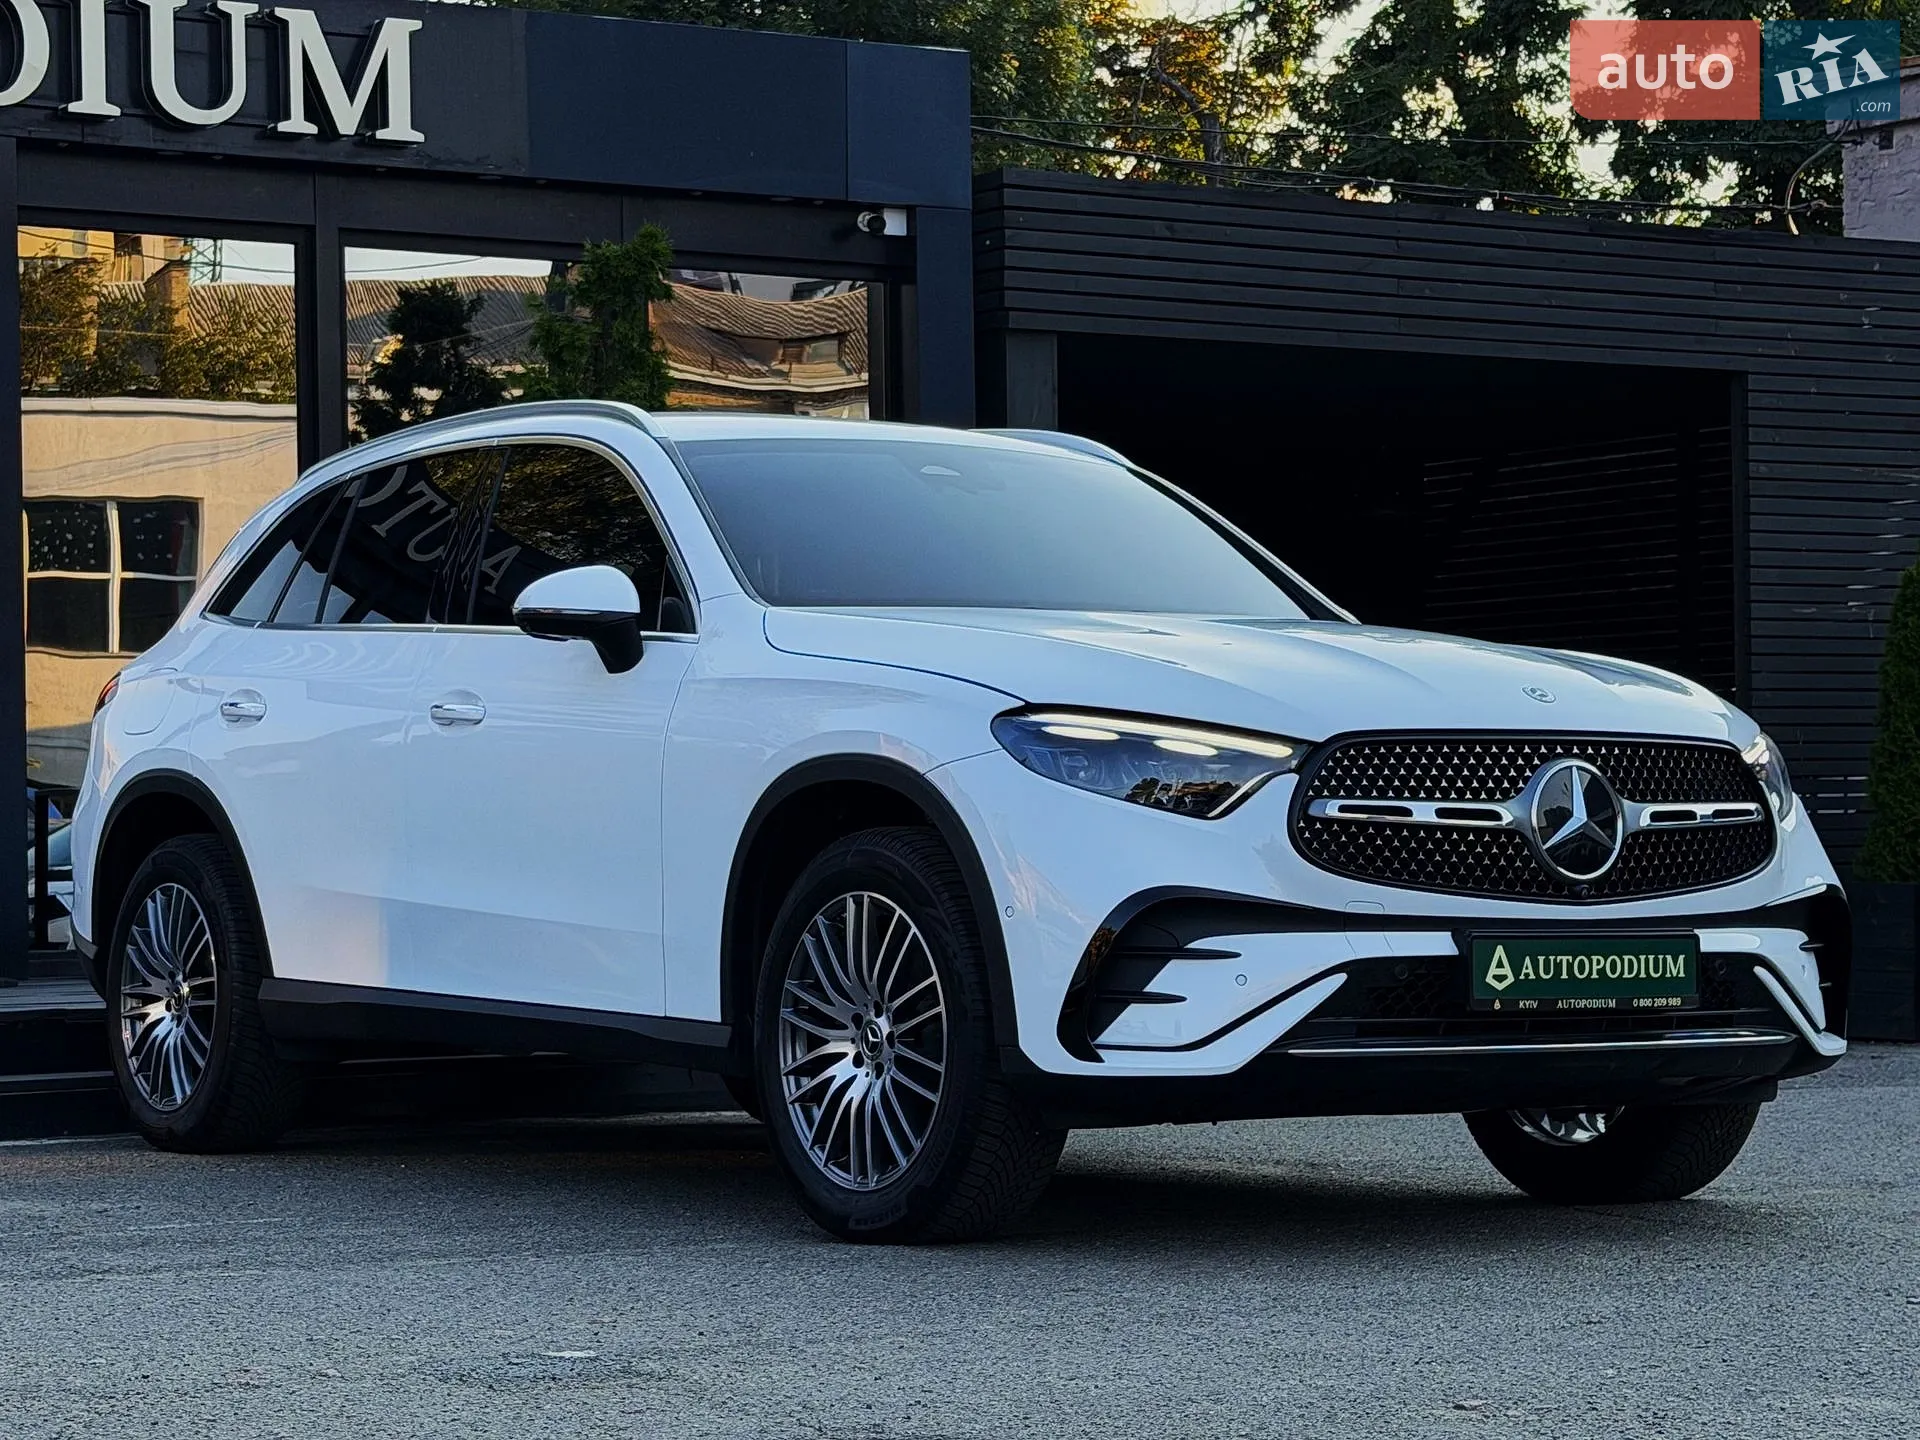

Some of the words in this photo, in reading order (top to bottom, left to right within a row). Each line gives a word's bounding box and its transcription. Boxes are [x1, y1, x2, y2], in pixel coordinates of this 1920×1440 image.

[1519, 954, 1686, 979] AUTOPODIUM
[1519, 1000, 1538, 1009] KYIV
[1557, 999, 1616, 1009] AUTOPODIUM
[1639, 998, 1653, 1007] 800
